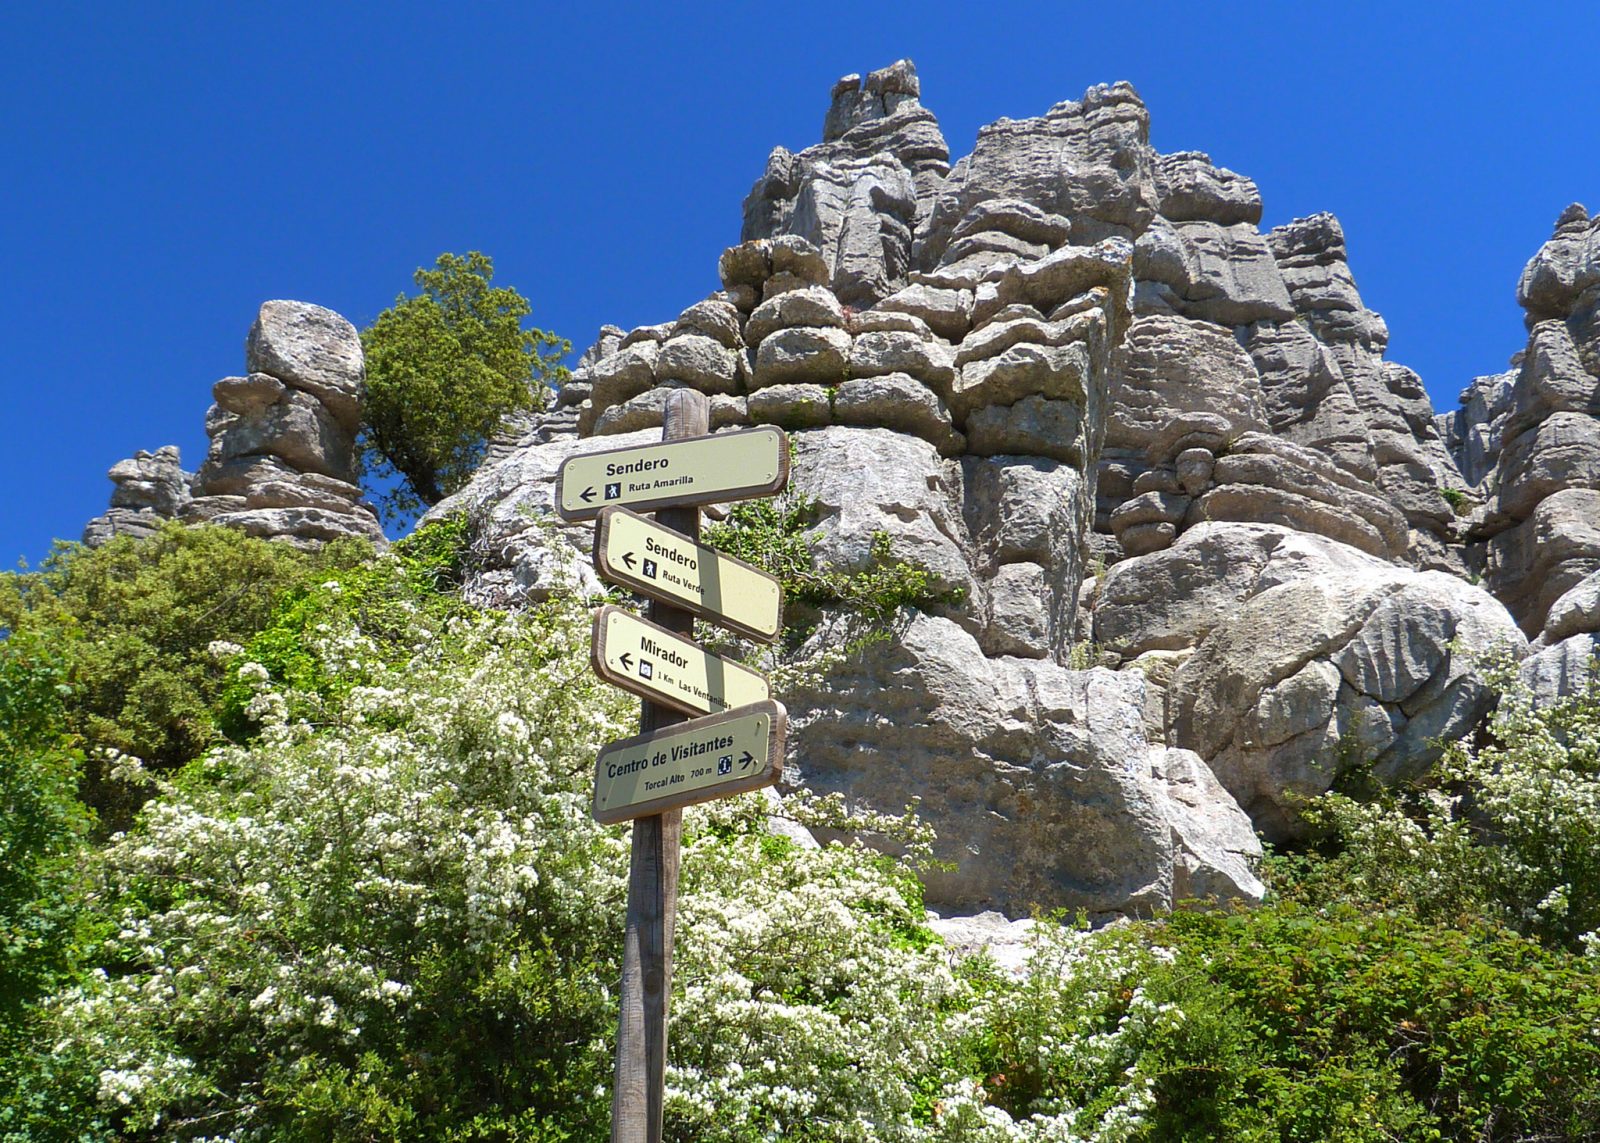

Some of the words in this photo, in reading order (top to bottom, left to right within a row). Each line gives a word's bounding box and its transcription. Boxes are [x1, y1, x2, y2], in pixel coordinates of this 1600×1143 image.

[606, 458, 669, 477] Sendero
[629, 482, 651, 493] Ruta
[653, 475, 694, 489] Amarilla
[645, 537, 697, 570] Sendero
[662, 570, 681, 586] Ruta
[682, 578, 705, 595] Verde
[640, 636, 689, 669] Mirador
[657, 671, 662, 679] 1
[663, 674, 674, 685] Km
[678, 679, 692, 693] Las
[693, 686, 732, 710] Ventanillas
[607, 757, 648, 779] Centro
[652, 752, 667, 767] de
[671, 735, 734, 762] Visitantes
[644, 777, 668, 791] Torcal
[669, 774, 685, 784] Alto
[690, 767, 704, 778] 700
